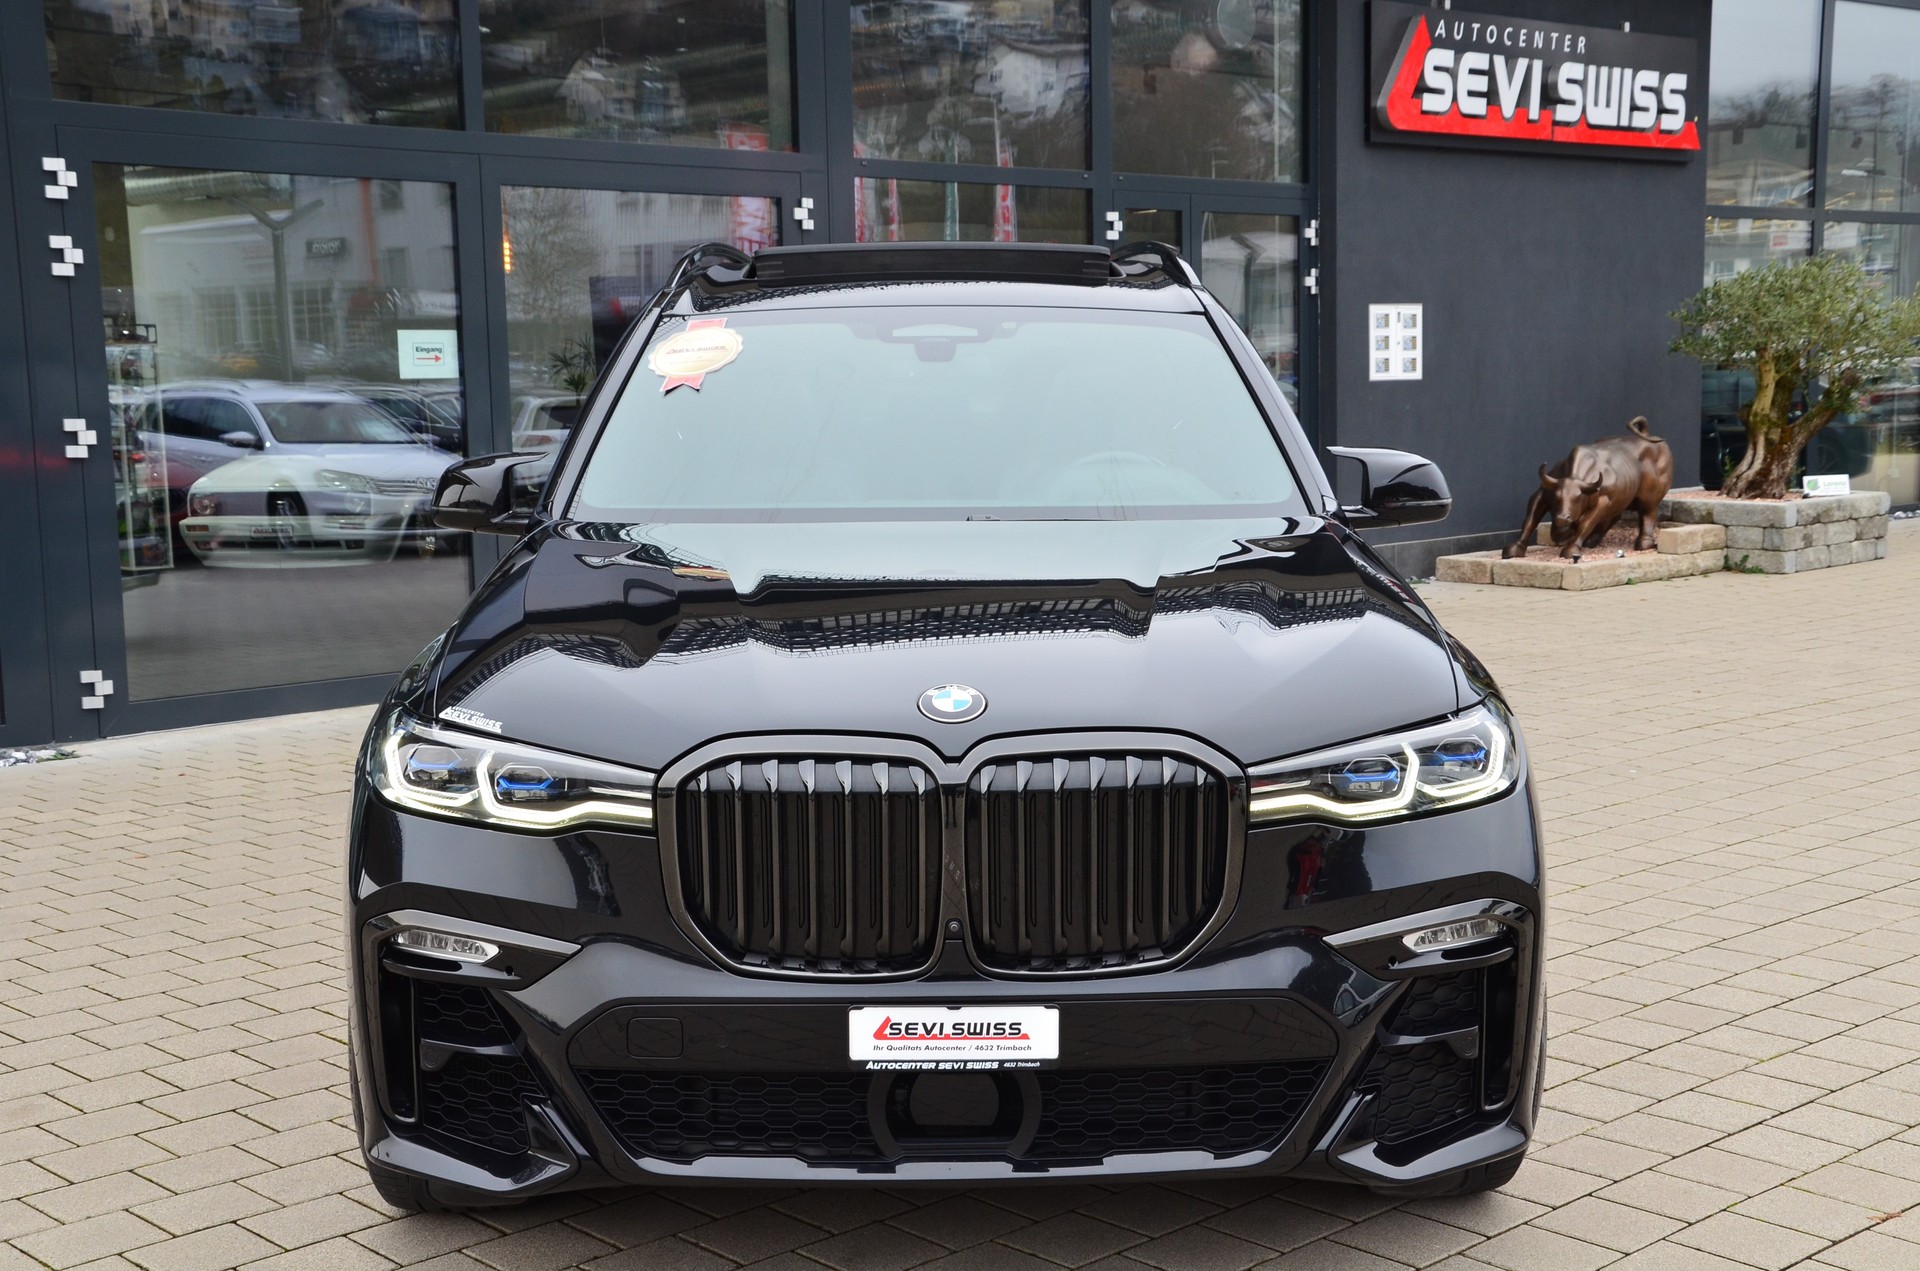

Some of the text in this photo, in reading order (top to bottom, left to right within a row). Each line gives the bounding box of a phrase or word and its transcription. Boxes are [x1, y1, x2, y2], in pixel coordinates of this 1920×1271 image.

[1434, 18, 1587, 55] AUTOCENTER
[1420, 47, 1688, 132] SEVI SWISS
[415, 345, 443, 354] Eingang
[471, 715, 503, 730] SWISS
[888, 1022, 1022, 1036] SEVI SWISS
[937, 1061, 965, 1070] SEVI
[965, 1061, 1000, 1070] SWISS
